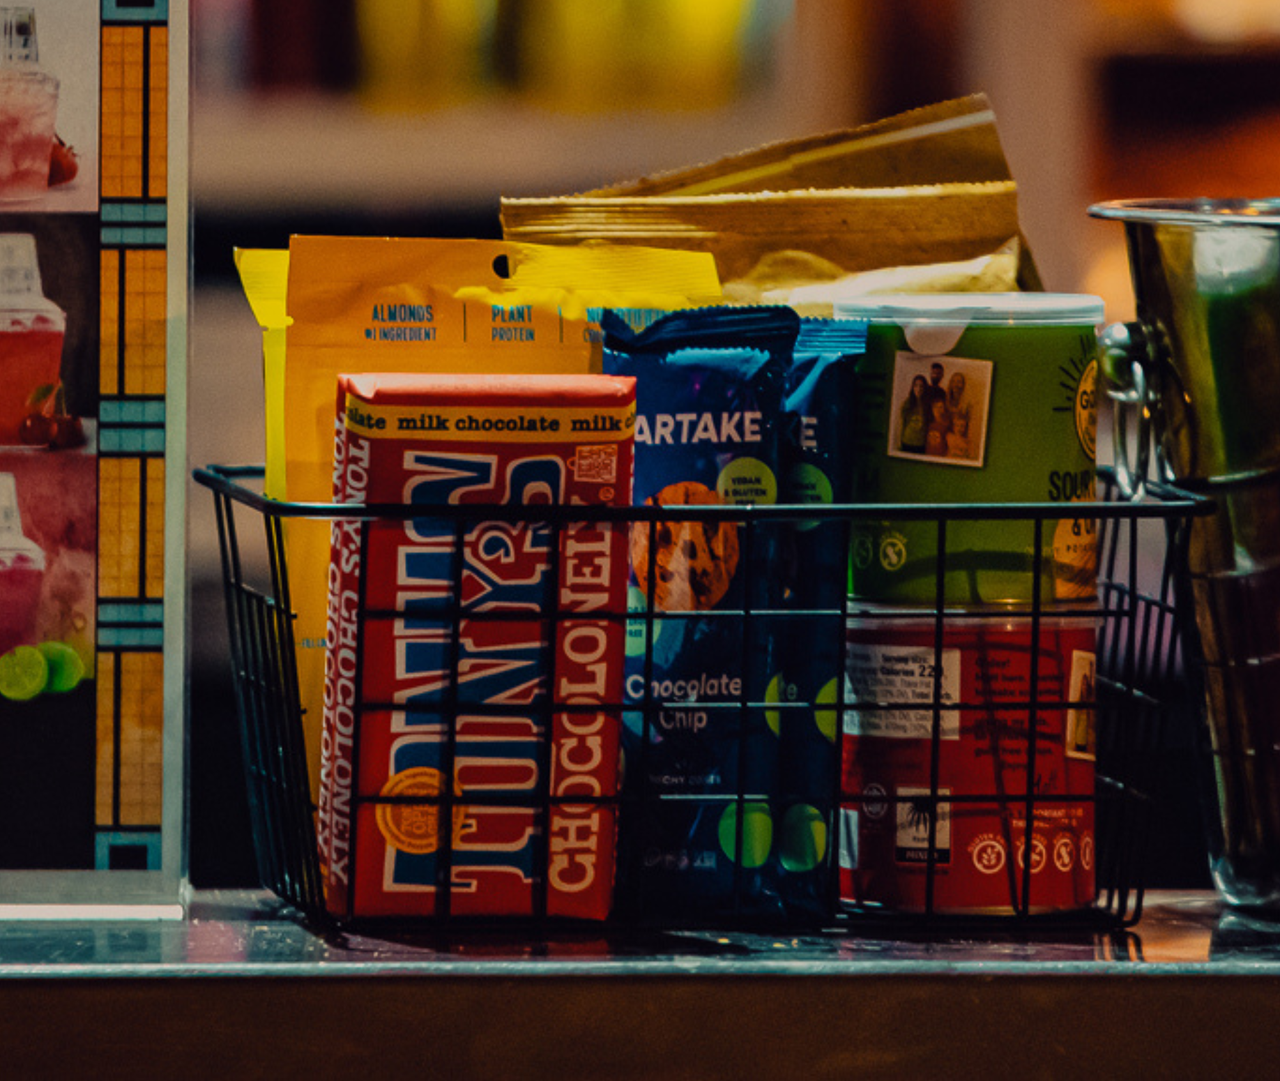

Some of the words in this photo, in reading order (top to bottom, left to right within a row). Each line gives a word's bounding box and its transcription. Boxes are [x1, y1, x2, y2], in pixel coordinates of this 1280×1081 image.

[372, 304, 434, 322] ALMONDS
[491, 304, 533, 323] PLANT
[379, 327, 437, 341] INGREDIENT
[491, 328, 535, 342] PROTEIN
[396, 409, 450, 431] milk
[454, 409, 561, 432] chocolate
[570, 410, 621, 432] milk
[635, 411, 764, 445] ARTAKE
[731, 476, 762, 485] VEGAN
[731, 488, 767, 497] GLUTEN
